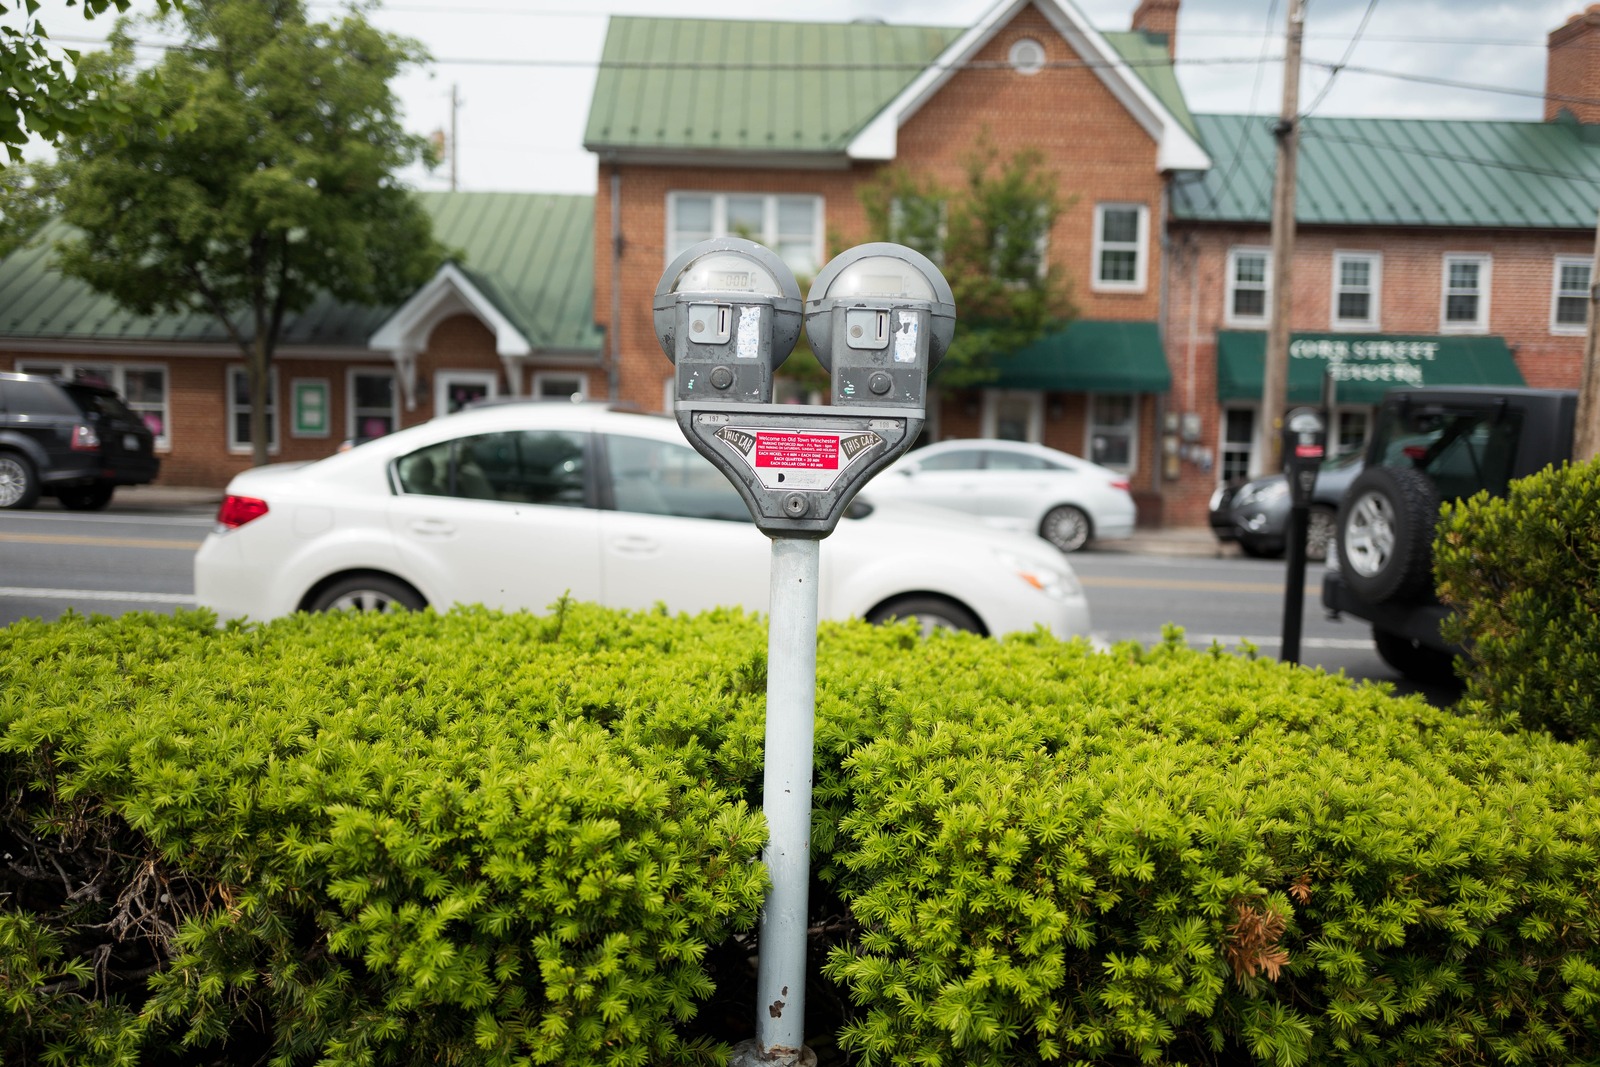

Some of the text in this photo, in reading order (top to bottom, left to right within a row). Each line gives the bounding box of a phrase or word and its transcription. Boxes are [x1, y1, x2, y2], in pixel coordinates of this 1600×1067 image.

[1352, 341, 1439, 361] STREET
[724, 430, 754, 453] THIS CAR
[844, 435, 875, 455] THIS CAR
